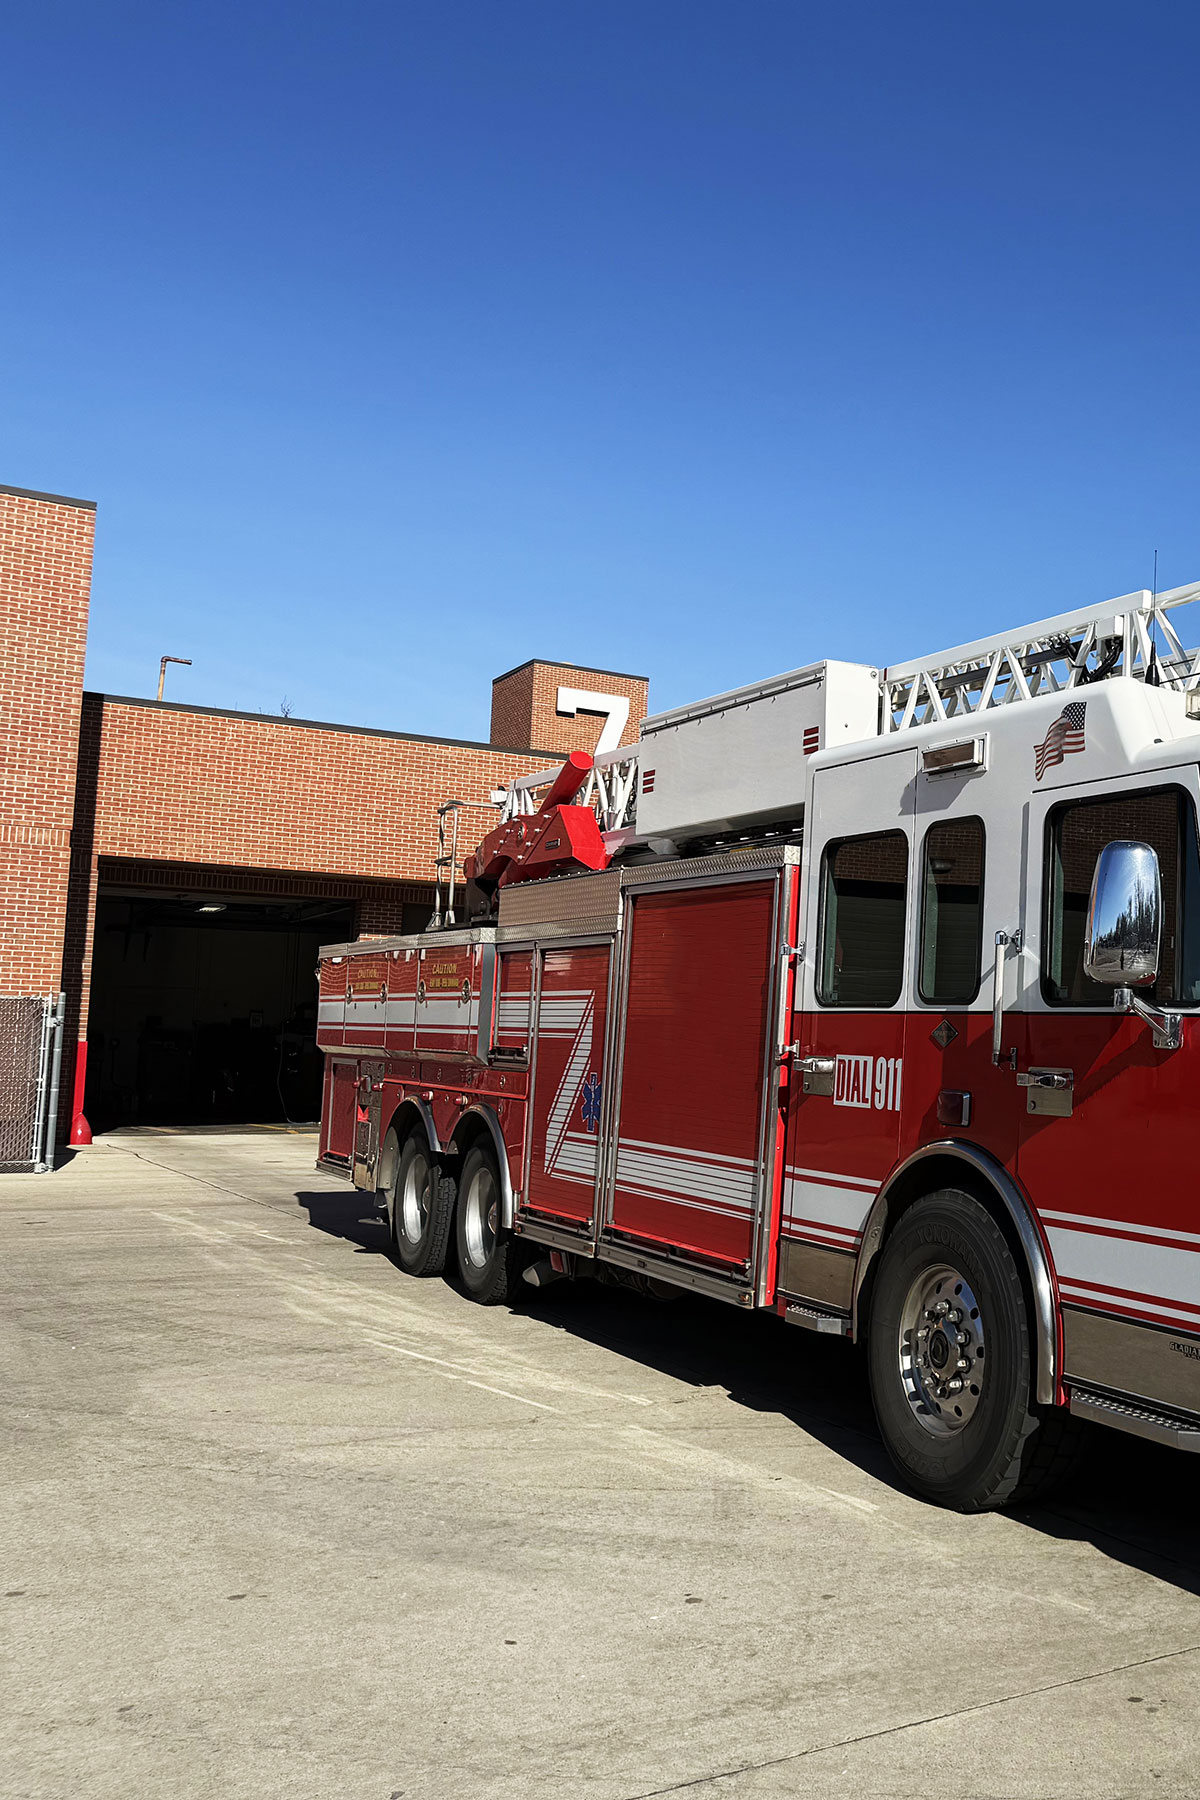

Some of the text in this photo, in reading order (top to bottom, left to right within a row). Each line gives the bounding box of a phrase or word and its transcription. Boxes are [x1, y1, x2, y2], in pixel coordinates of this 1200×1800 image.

[556, 686, 630, 757] 7
[432, 963, 457, 975] CAUTION
[835, 1056, 903, 1112] DIAL 911
